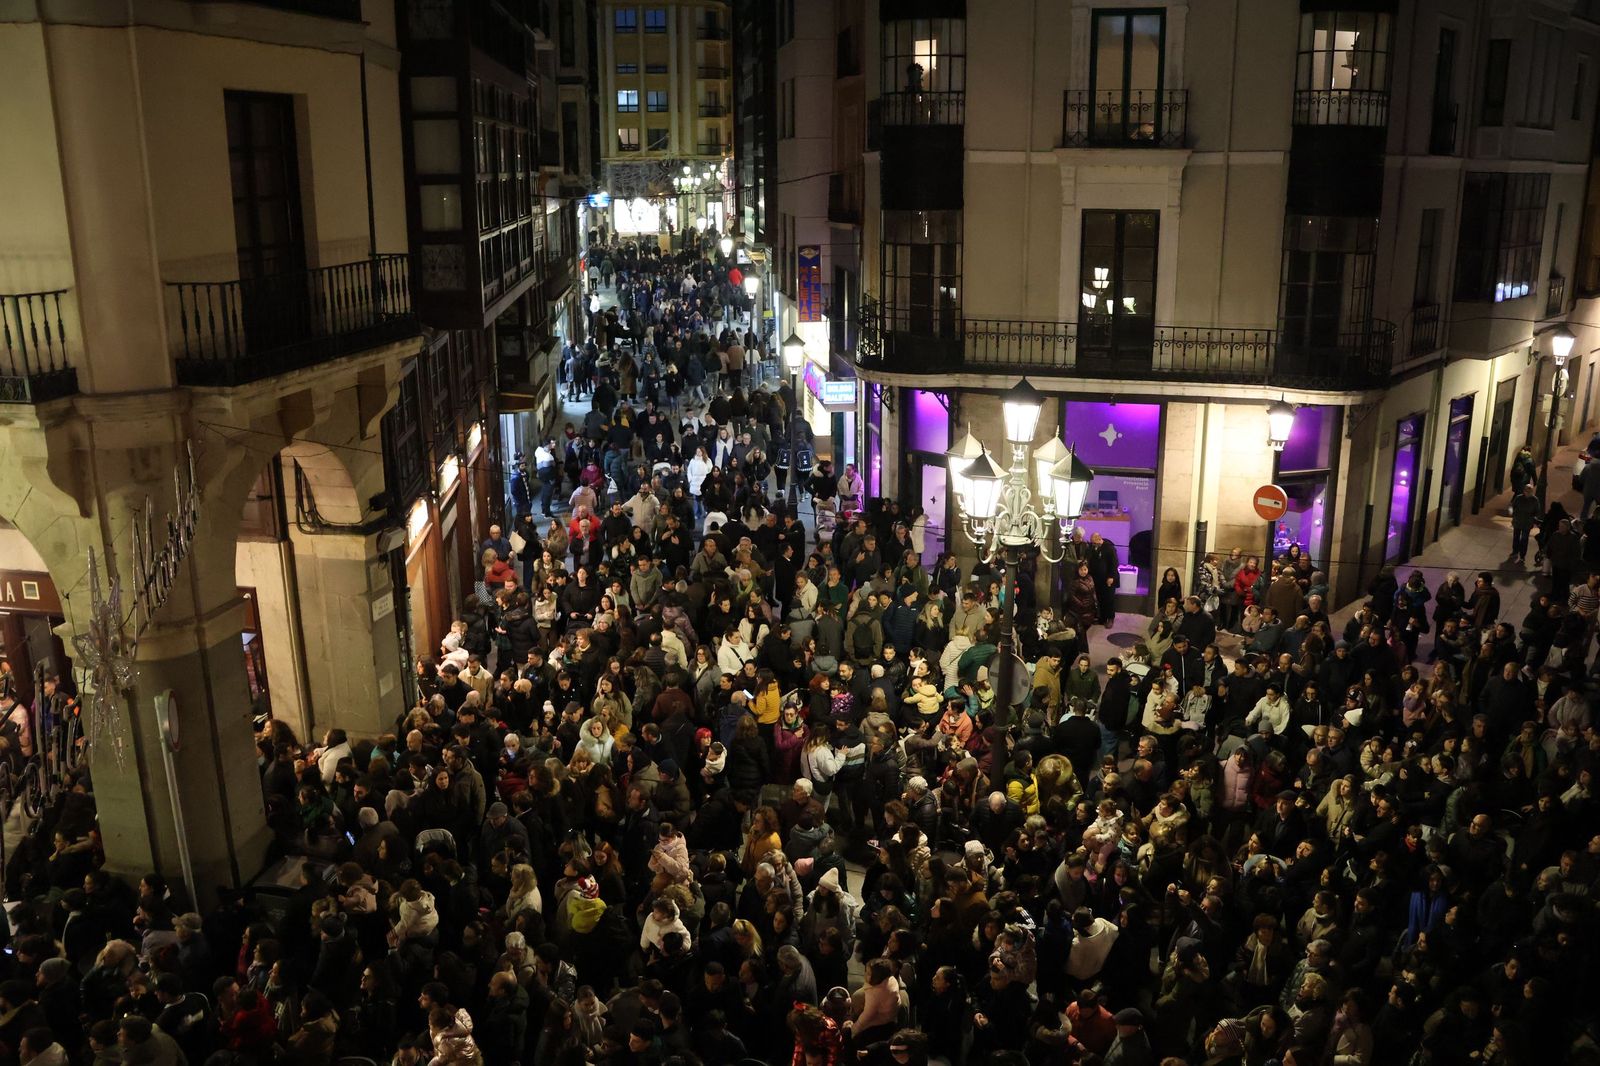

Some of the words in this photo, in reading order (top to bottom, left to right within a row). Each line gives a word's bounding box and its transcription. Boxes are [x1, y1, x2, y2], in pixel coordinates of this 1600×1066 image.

[800, 266, 809, 321] MALETAS
[811, 266, 820, 321] BOLSOS
[0, 581, 16, 603] A
